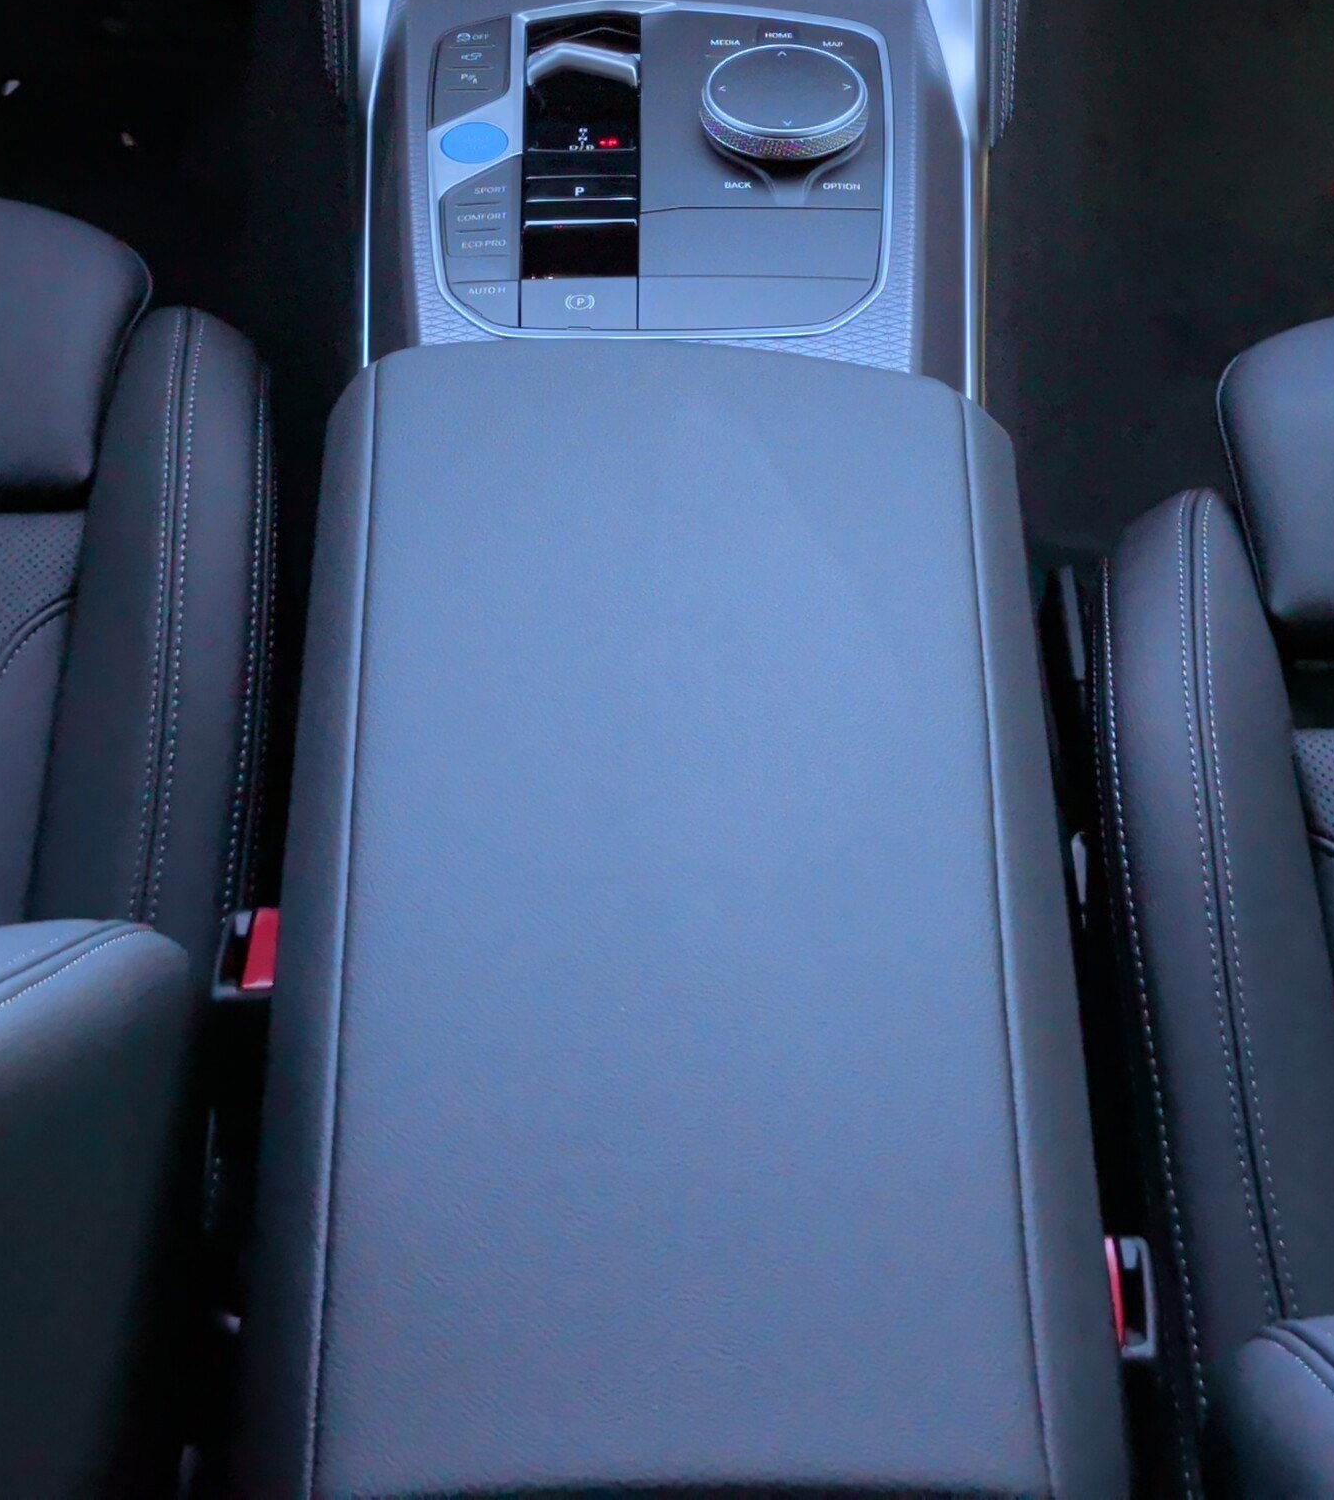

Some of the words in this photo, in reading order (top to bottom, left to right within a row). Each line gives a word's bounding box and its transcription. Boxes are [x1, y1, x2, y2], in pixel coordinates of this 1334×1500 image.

[764, 31, 794, 39] HOME
[710, 38, 741, 47] MEDIA
[474, 185, 507, 196] SPORT
[724, 181, 752, 190] BACK
[822, 181, 861, 191] OPTION
[574, 186, 586, 197] P
[456, 212, 507, 223] COMFORT
[461, 240, 483, 249] ECO
[484, 239, 507, 247] PRO
[468, 286, 496, 296] AUTO
